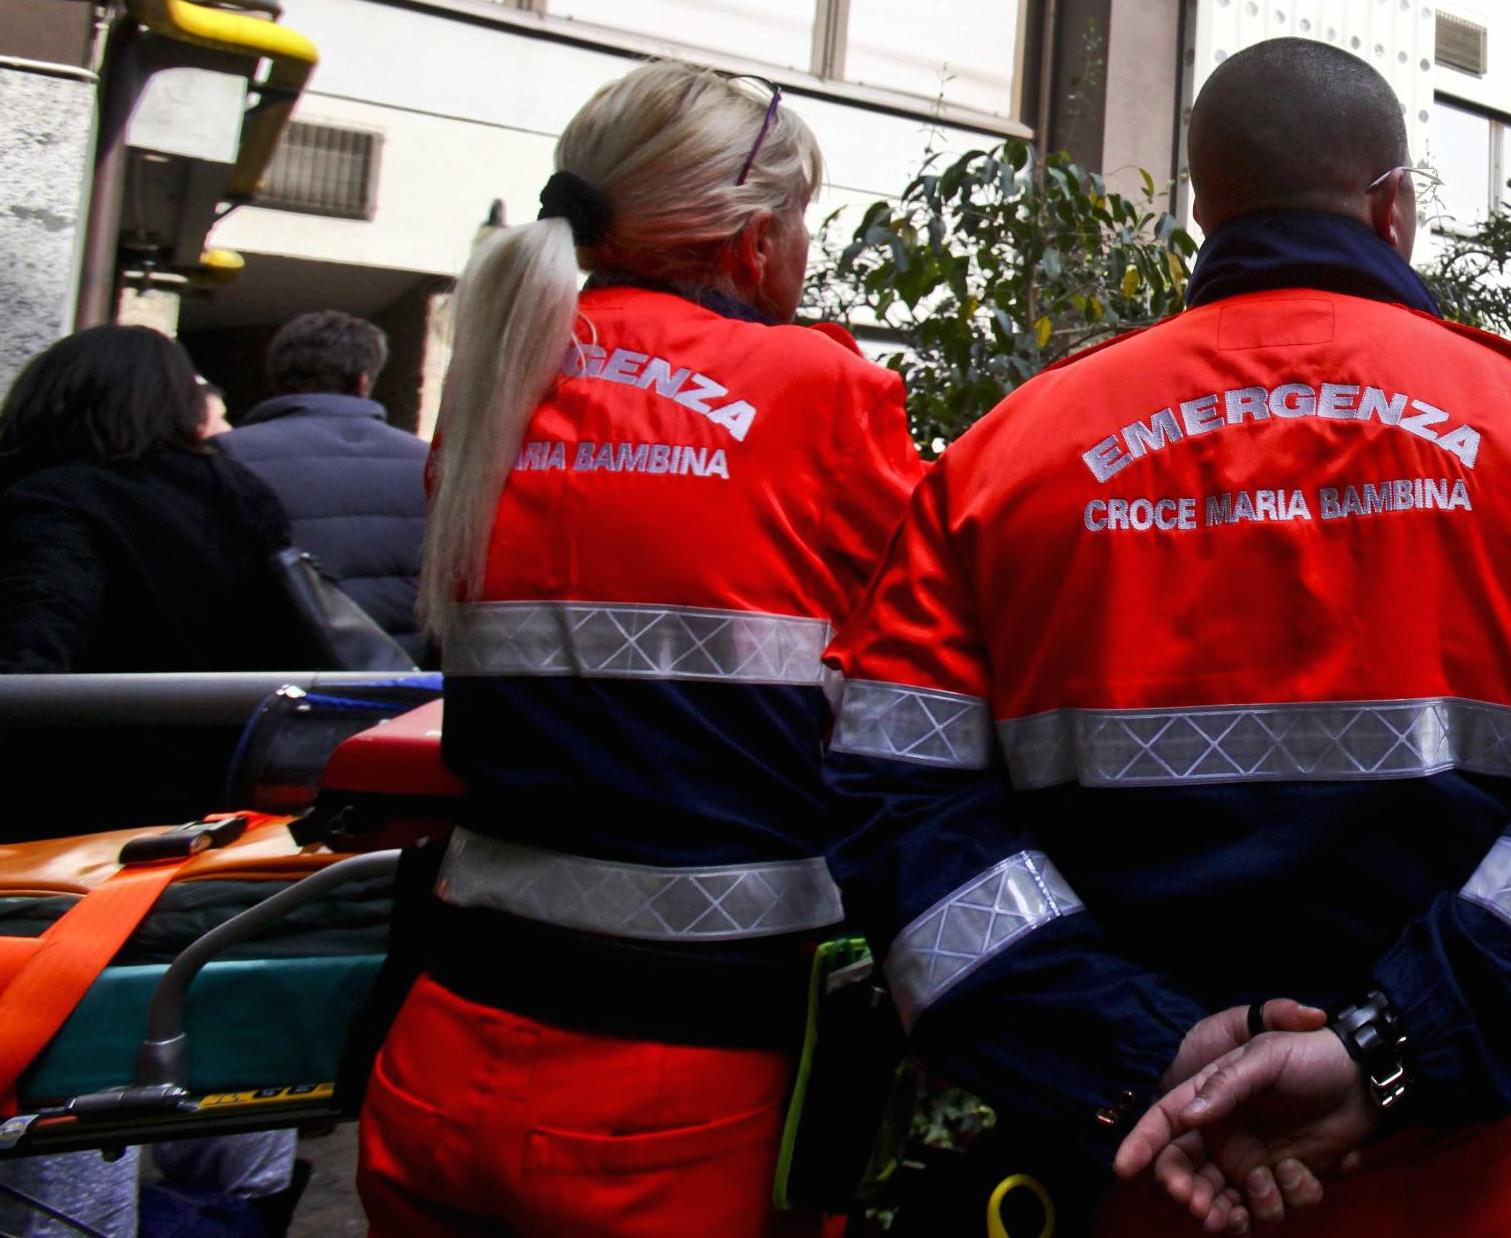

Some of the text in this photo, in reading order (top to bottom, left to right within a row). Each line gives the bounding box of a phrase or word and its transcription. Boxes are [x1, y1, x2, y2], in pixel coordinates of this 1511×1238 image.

[561, 343, 757, 442] GENZA
[574, 441, 730, 480] BAMBINA
[1082, 382, 1482, 484] EMERGENZA
[1084, 478, 1473, 532] CROCE MARIA BAMBINA
